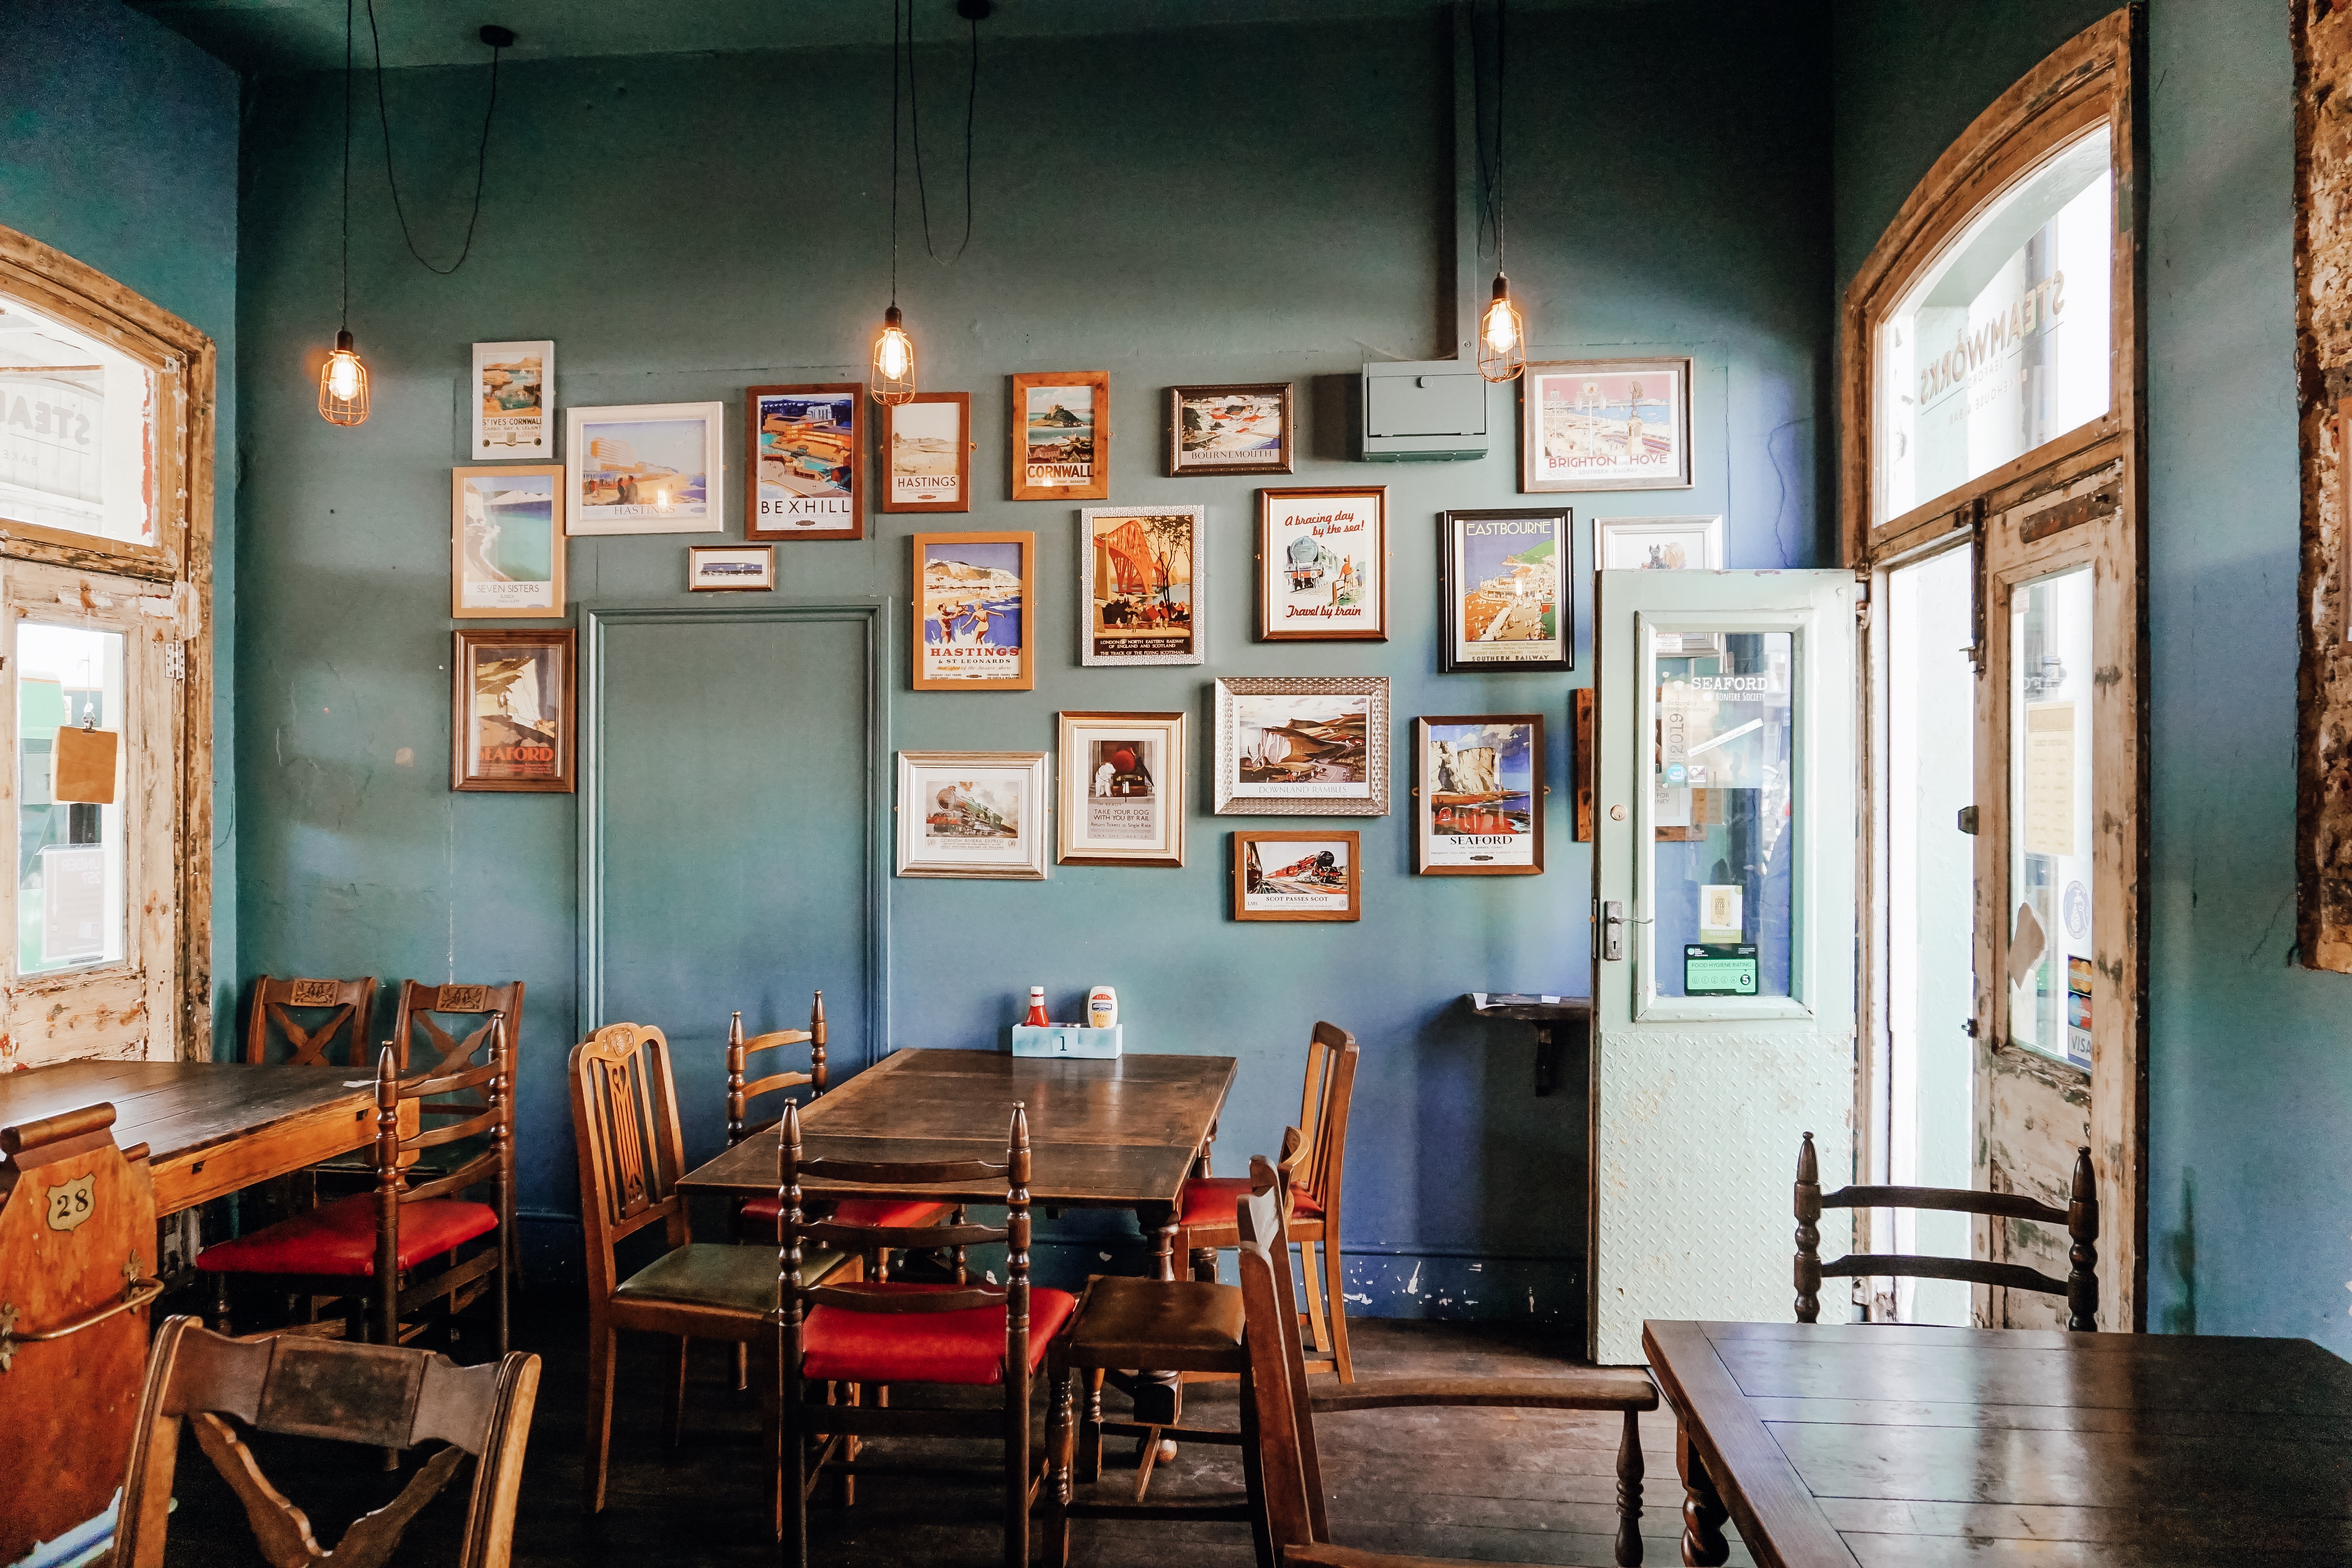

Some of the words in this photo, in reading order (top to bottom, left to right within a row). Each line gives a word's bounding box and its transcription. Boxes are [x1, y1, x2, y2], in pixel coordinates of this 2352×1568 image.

[1192, 450, 1271, 459] BOURNEMOUTH
[1549, 456, 1617, 468] BRIGHTON
[1630, 454, 1667, 465] HOVE
[1027, 465, 1094, 478] CORNWALL
[898, 477, 956, 487] HASTINGS
[761, 500, 850, 514] BEXHILL
[1285, 515, 1293, 526] A
[1294, 513, 1332, 525] bracing
[1335, 510, 1354, 522] day
[1312, 525, 1325, 538] by
[1326, 524, 1341, 534] the
[1343, 520, 1365, 532] sea!
[1466, 521, 1551, 536] EASTBOURNE
[1286, 605, 1318, 619] Travel
[1319, 605, 1333, 619] by
[1334, 604, 1361, 616] train
[1691, 677, 1768, 691] SEAFORD
[1670, 713, 1684, 753] 2019
[1691, 741, 1719, 755] PROGRAMMES
[1450, 836, 1512, 845] SEAFORD
[1742, 975, 1749, 984] 5
[1060, 1036, 1067, 1051] 1
[56, 1188, 89, 1220] 28
